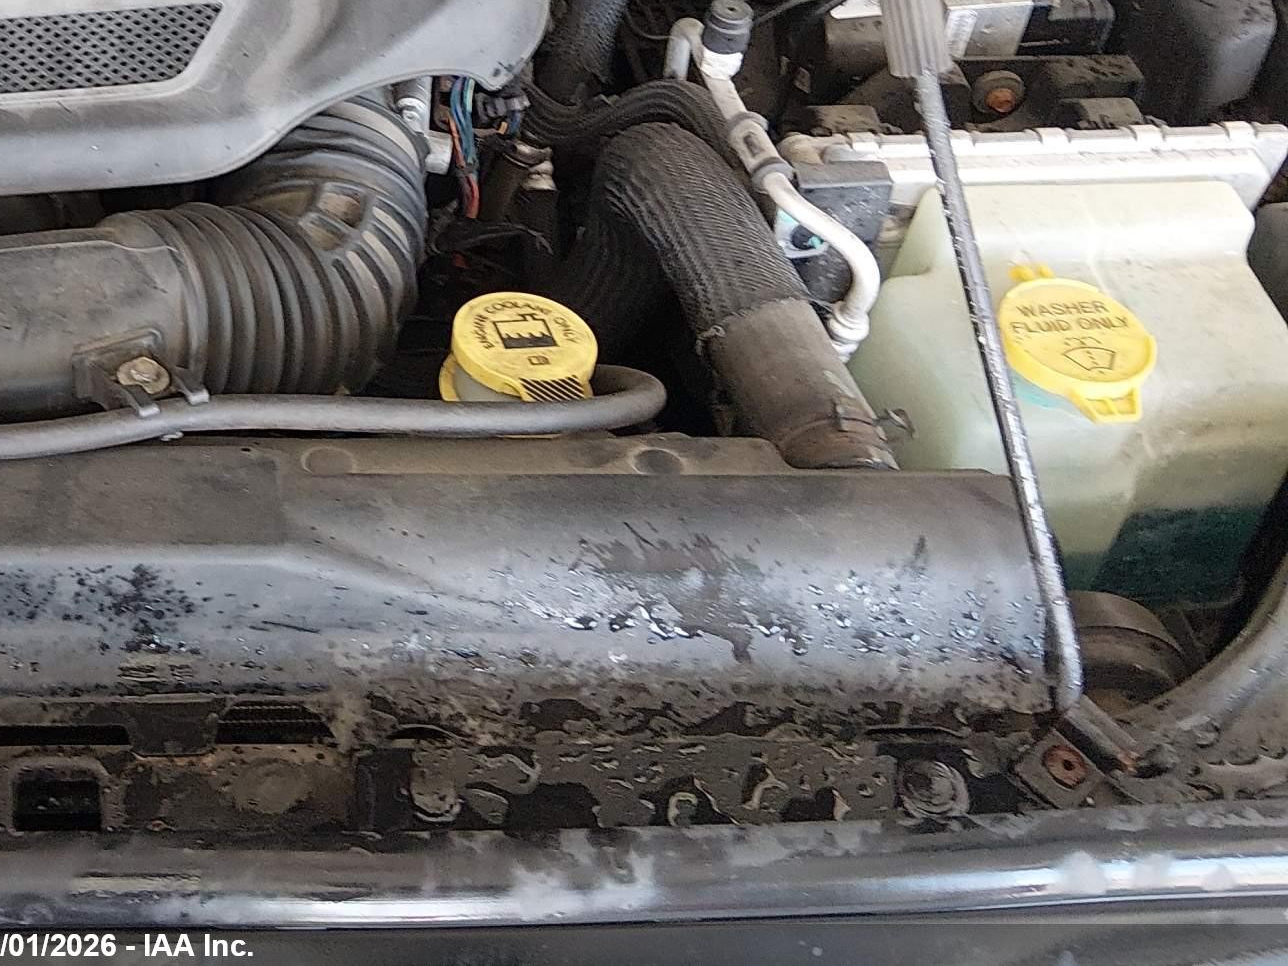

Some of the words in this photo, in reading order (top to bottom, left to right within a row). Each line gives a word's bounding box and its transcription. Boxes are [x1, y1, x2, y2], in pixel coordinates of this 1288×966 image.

[1015, 300, 1110, 318] WASHER
[471, 314, 495, 350] ENGINE
[485, 300, 553, 315] COOLANT
[553, 316, 580, 344] ONLY
[1010, 319, 1072, 333] FLUID
[1076, 316, 1129, 331] ONLY
